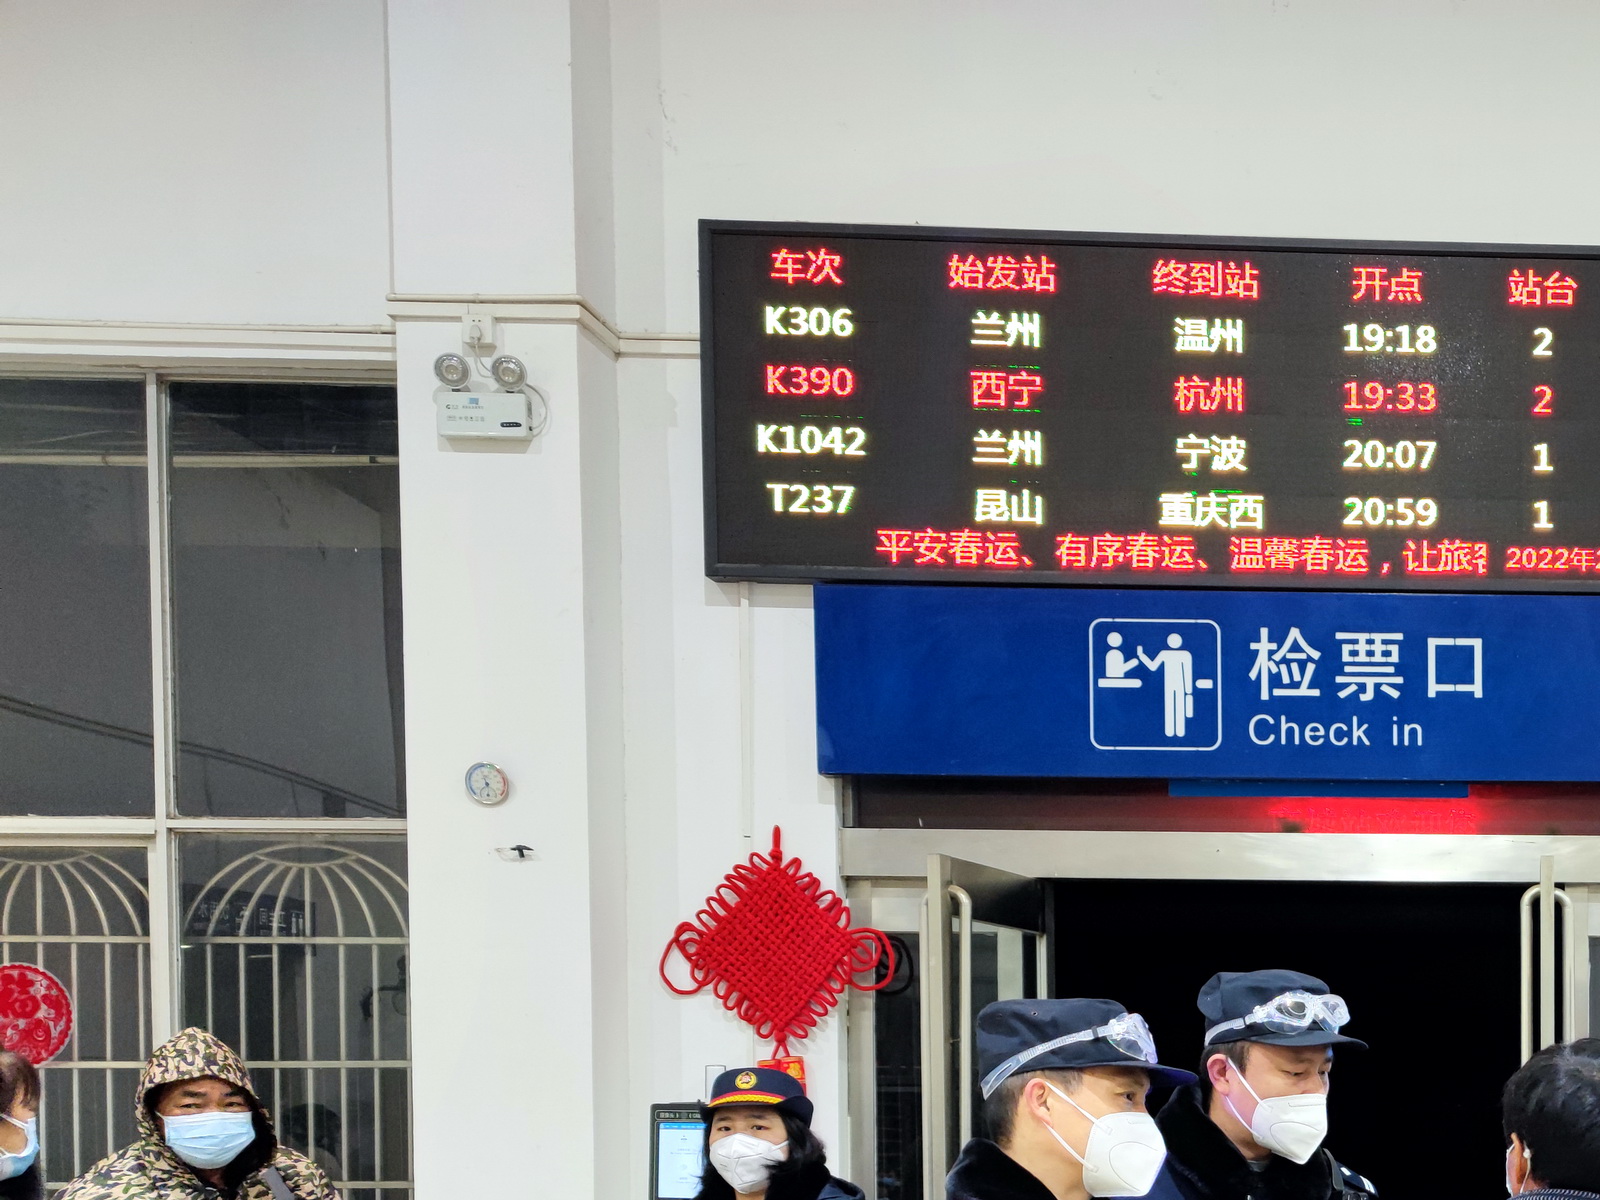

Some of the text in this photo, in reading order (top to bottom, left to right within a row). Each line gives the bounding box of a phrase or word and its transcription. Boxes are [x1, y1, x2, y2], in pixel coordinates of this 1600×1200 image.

[770, 248, 844, 286] 车次
[948, 253, 1057, 294] 始发站
[1152, 259, 1260, 300] 终到站
[1352, 267, 1424, 303] 开点
[1508, 269, 1578, 307] 站台
[764, 306, 854, 338] K306
[970, 311, 1042, 348] 兰州
[1173, 317, 1244, 354] 温州
[1342, 323, 1438, 354] 19:18
[1532, 327, 1554, 357] 2
[764, 365, 855, 397] K390
[969, 370, 1043, 408] 西宁
[1173, 375, 1245, 413] 杭州
[1342, 381, 1438, 412] 19:33
[1532, 385, 1554, 415] 2
[756, 424, 867, 456] K1042
[971, 429, 1043, 466] 兰州
[1175, 434, 1248, 472] 宁波
[1341, 440, 1438, 471] 20:07
[1532, 443, 1554, 472] 1
[766, 484, 855, 514] T237
[974, 489, 1044, 525] 昆山
[1158, 492, 1265, 530] 重庆西
[1341, 496, 1438, 527] 20:59
[1532, 500, 1554, 529] 1
[1248, 626, 1484, 702] 检票口
[1248, 714, 1423, 747] Check in
